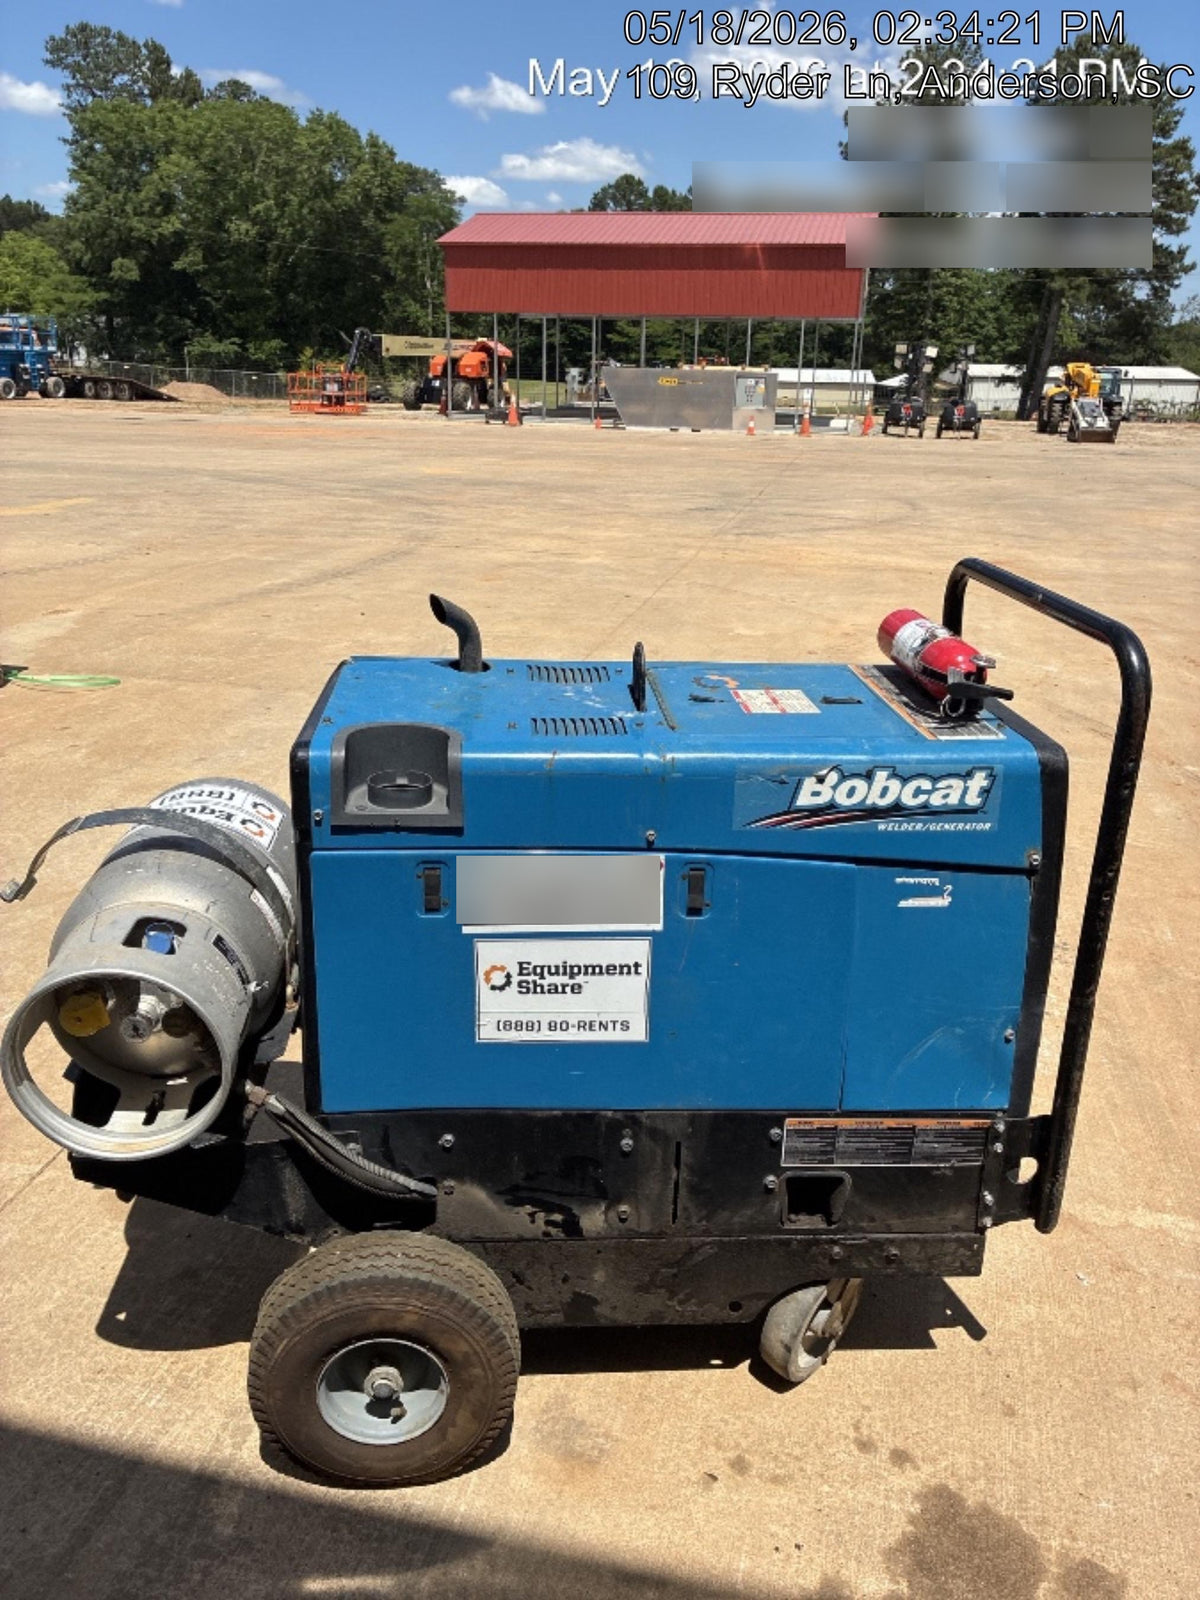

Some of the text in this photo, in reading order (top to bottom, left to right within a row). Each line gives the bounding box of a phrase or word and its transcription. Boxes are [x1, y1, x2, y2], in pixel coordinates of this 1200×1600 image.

[794, 766, 991, 807] Bobcat
[877, 822, 992, 832] WELDER/GENERATOR
[516, 961, 642, 980] Equipment
[547, 1019, 630, 1032] 80-RENTS
